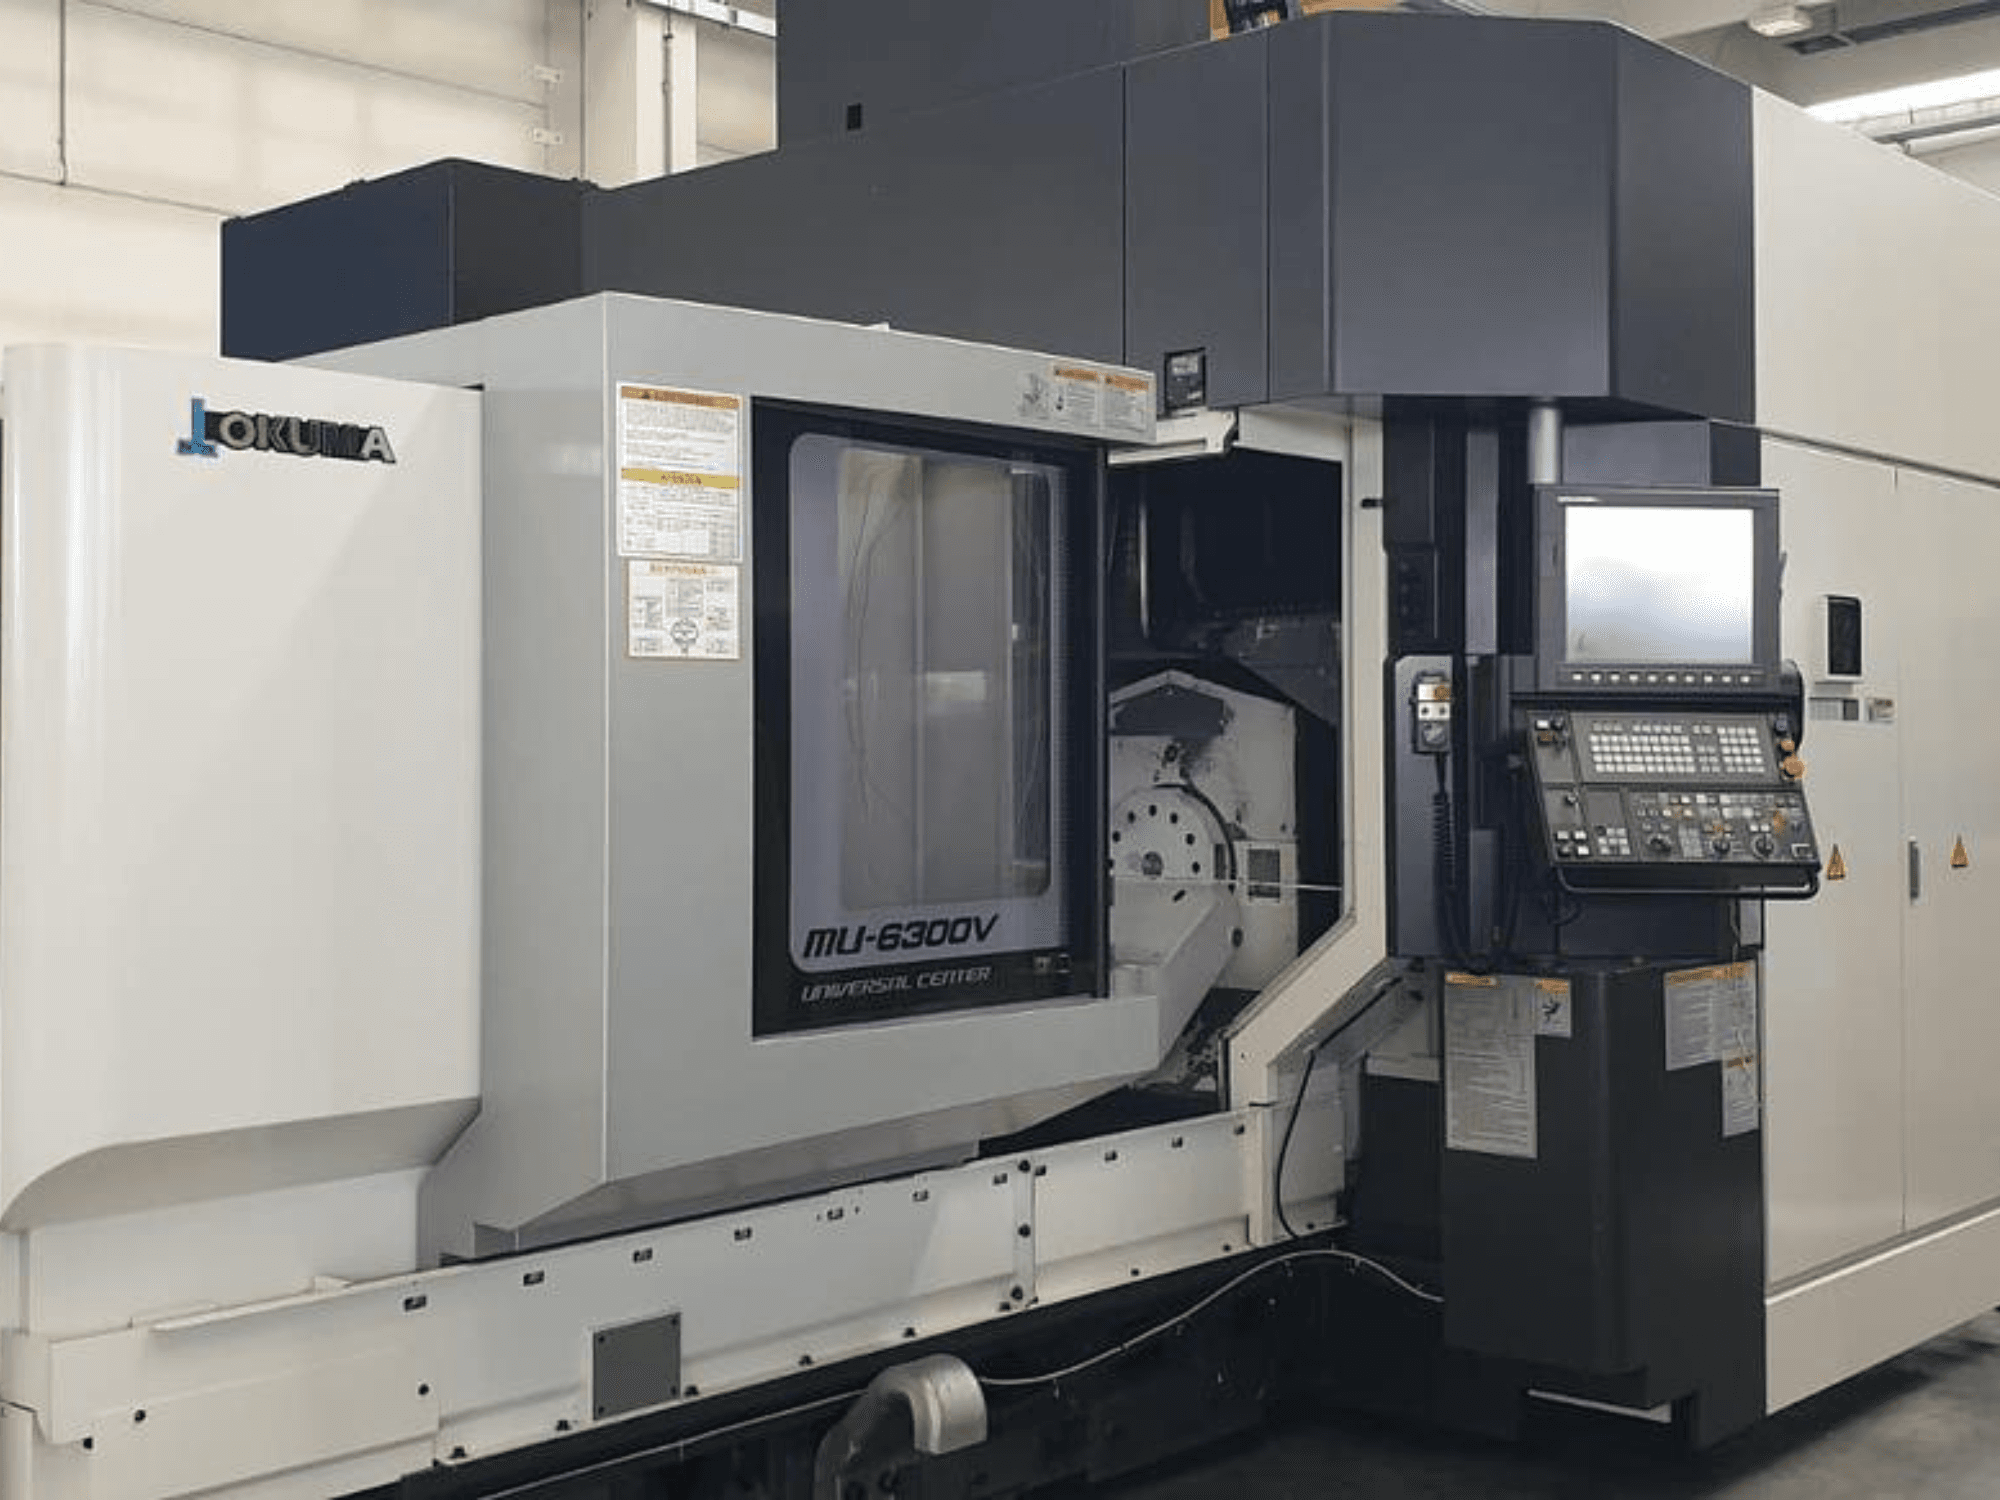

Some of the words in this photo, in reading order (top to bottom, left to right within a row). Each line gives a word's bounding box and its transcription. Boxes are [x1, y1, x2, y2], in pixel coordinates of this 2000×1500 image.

[218, 411, 396, 464] OKUMA
[803, 913, 999, 958] MU-6300V
[801, 976, 912, 1003] UNIVERSAL
[916, 966, 993, 989] CENTER
